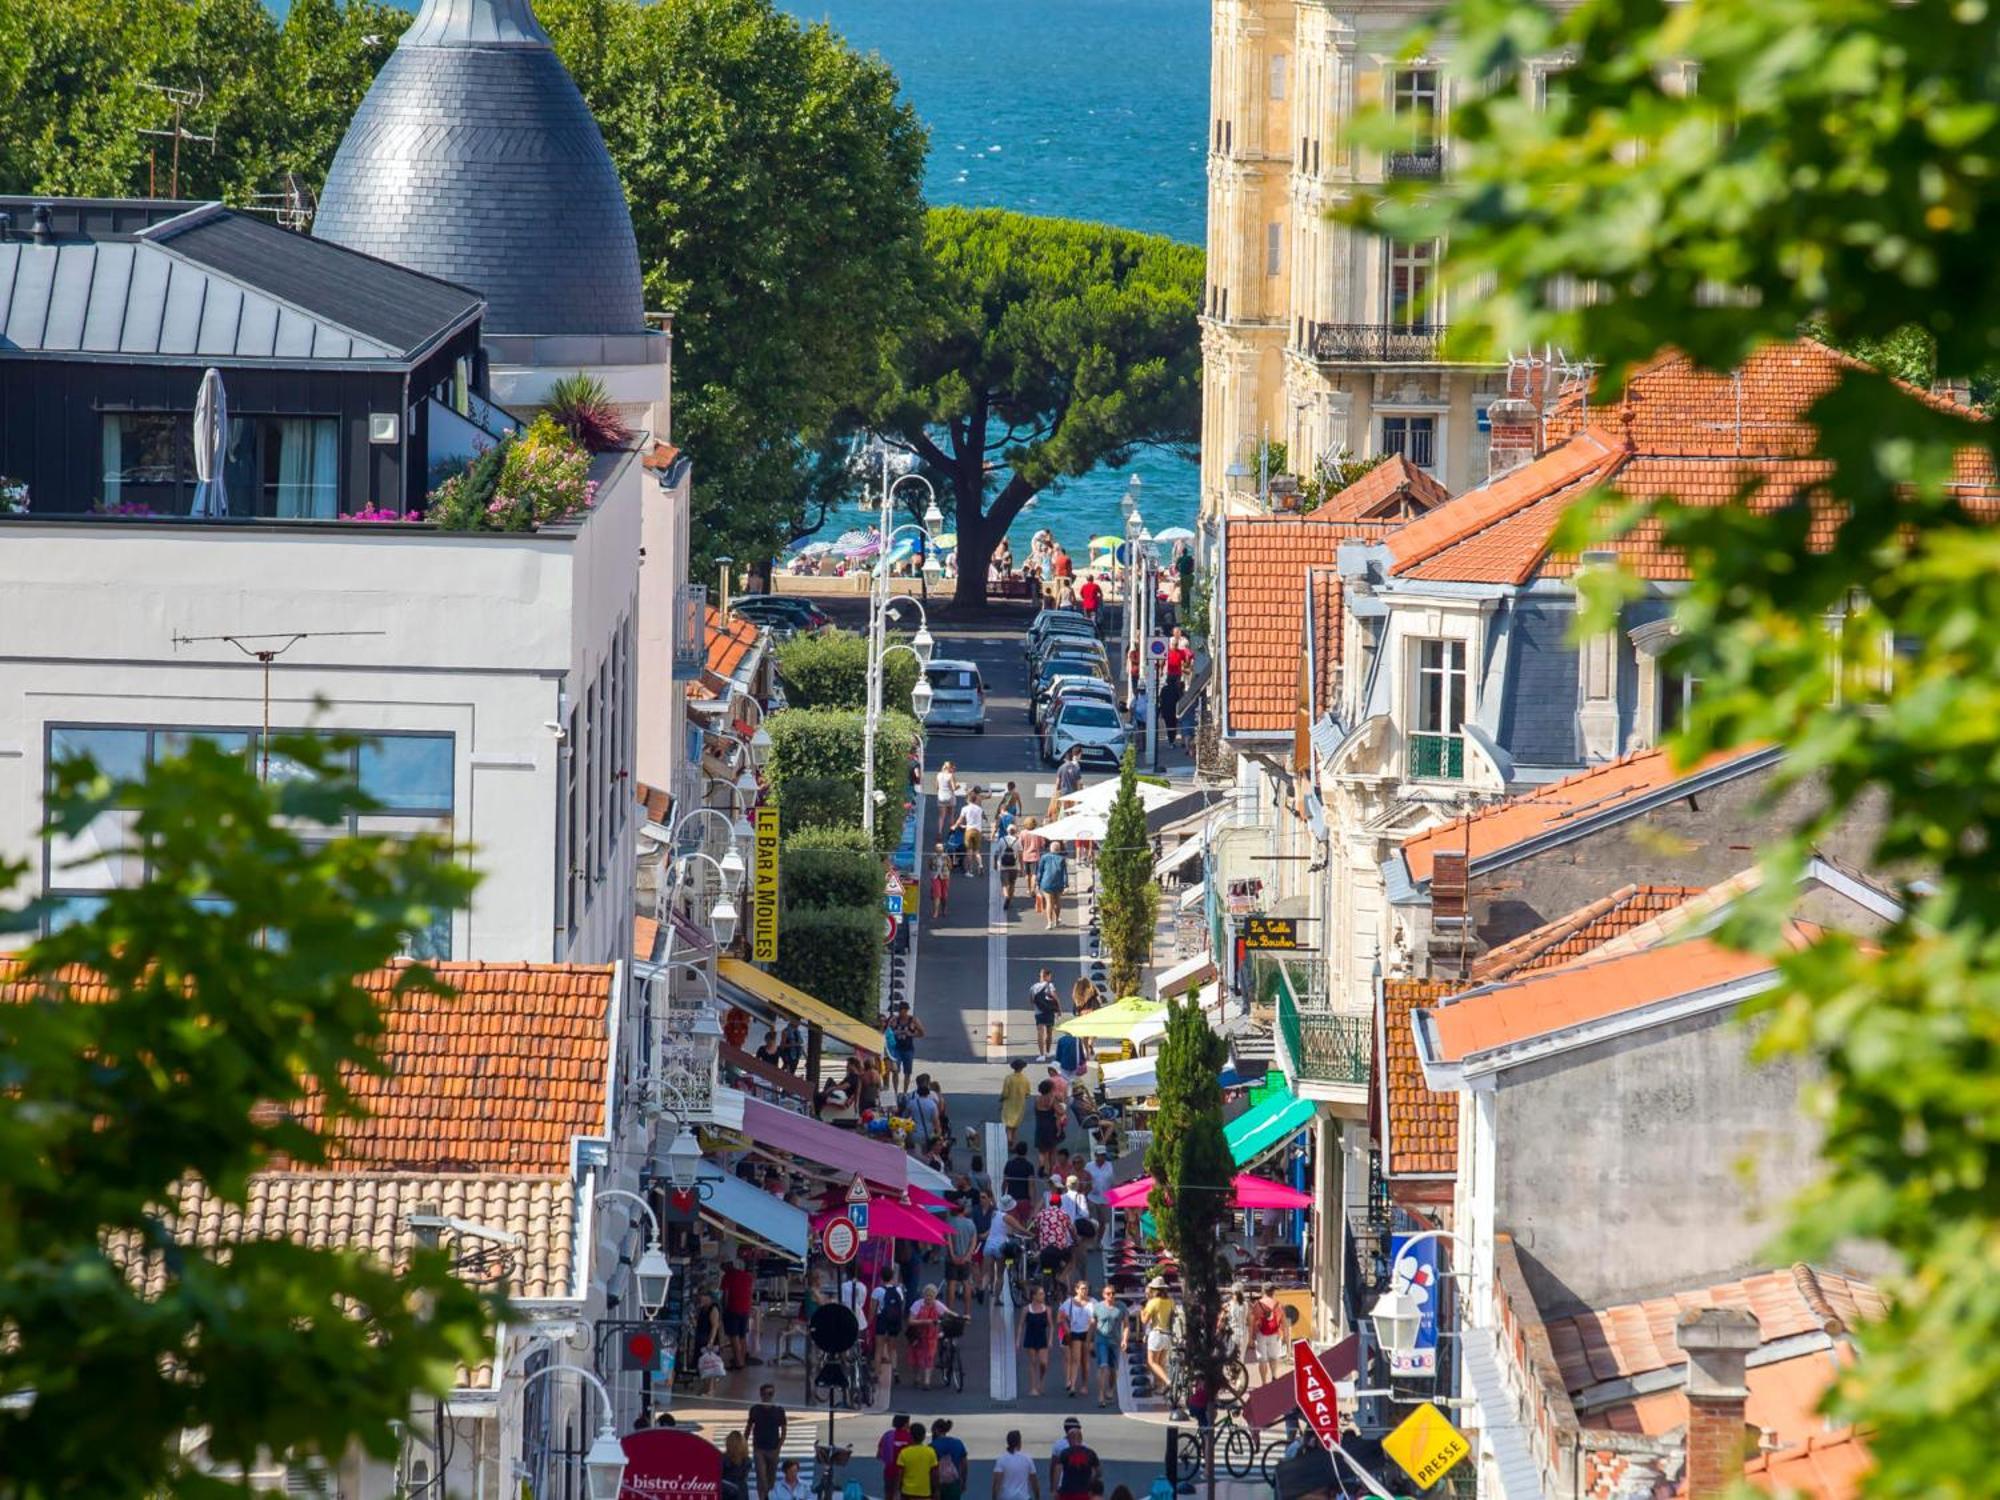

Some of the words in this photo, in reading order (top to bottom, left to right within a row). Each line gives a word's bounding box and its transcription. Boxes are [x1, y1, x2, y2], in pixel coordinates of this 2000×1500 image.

[757, 812, 777, 832] LE
[757, 839, 777, 869] BAR
[756, 890, 776, 958] MOULES
[1246, 935, 1258, 947] du
[1303, 1365, 1331, 1426] TABAC
[1417, 1441, 1461, 1482] PRESSE
